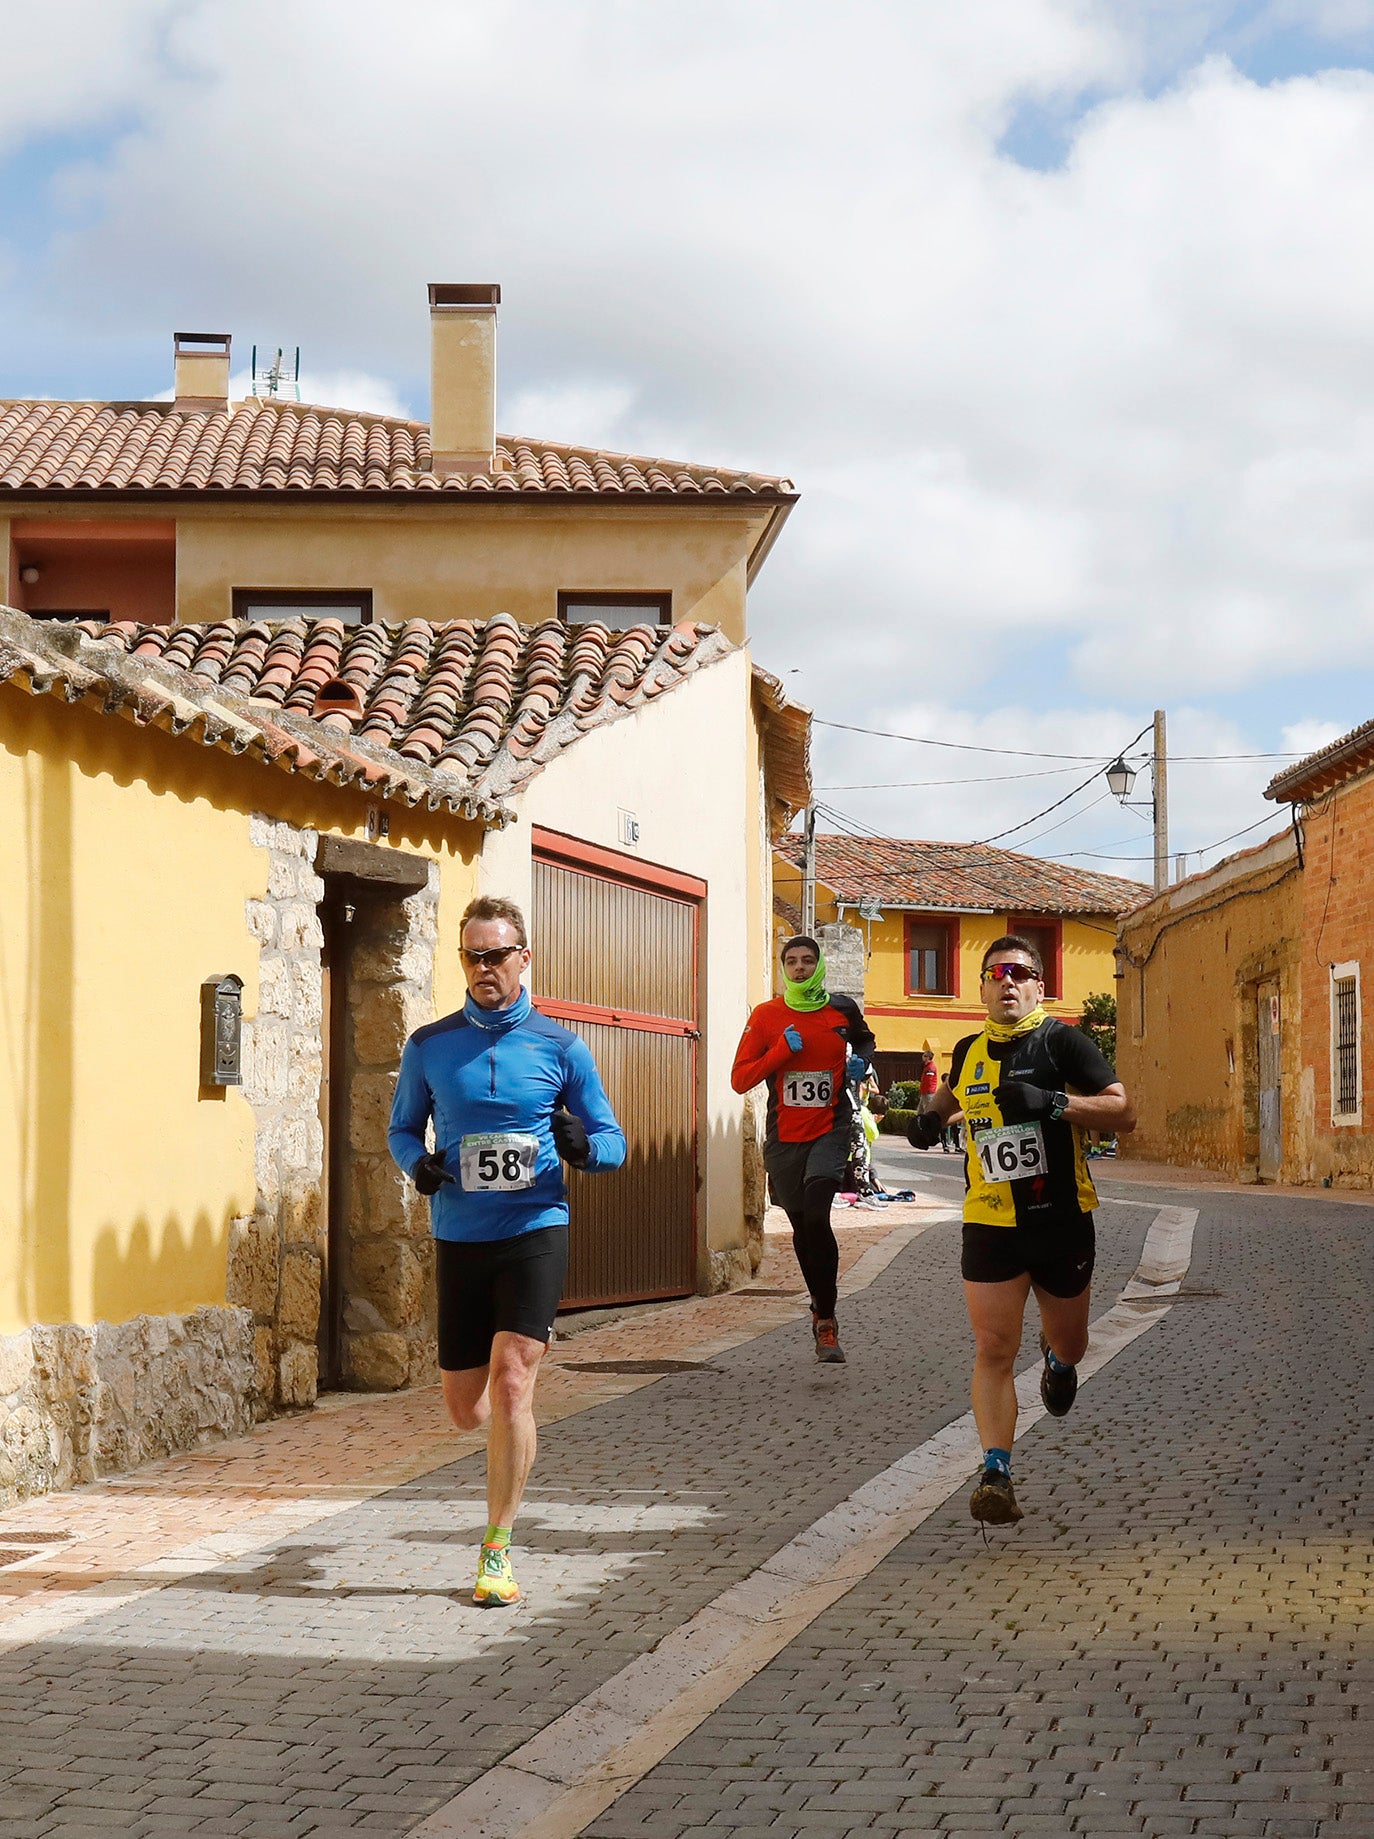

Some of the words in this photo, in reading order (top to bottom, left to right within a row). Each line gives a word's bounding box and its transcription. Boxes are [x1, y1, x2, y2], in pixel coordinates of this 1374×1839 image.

[369, 810, 375, 832] 8
[787, 1080, 830, 1101] 136
[993, 1125, 1023, 1134] CARRERA
[997, 1127, 1035, 1137] CASTILLOS
[467, 1139, 491, 1147] ENTRE
[478, 1149, 521, 1182] 58
[980, 1137, 1041, 1174] 165
